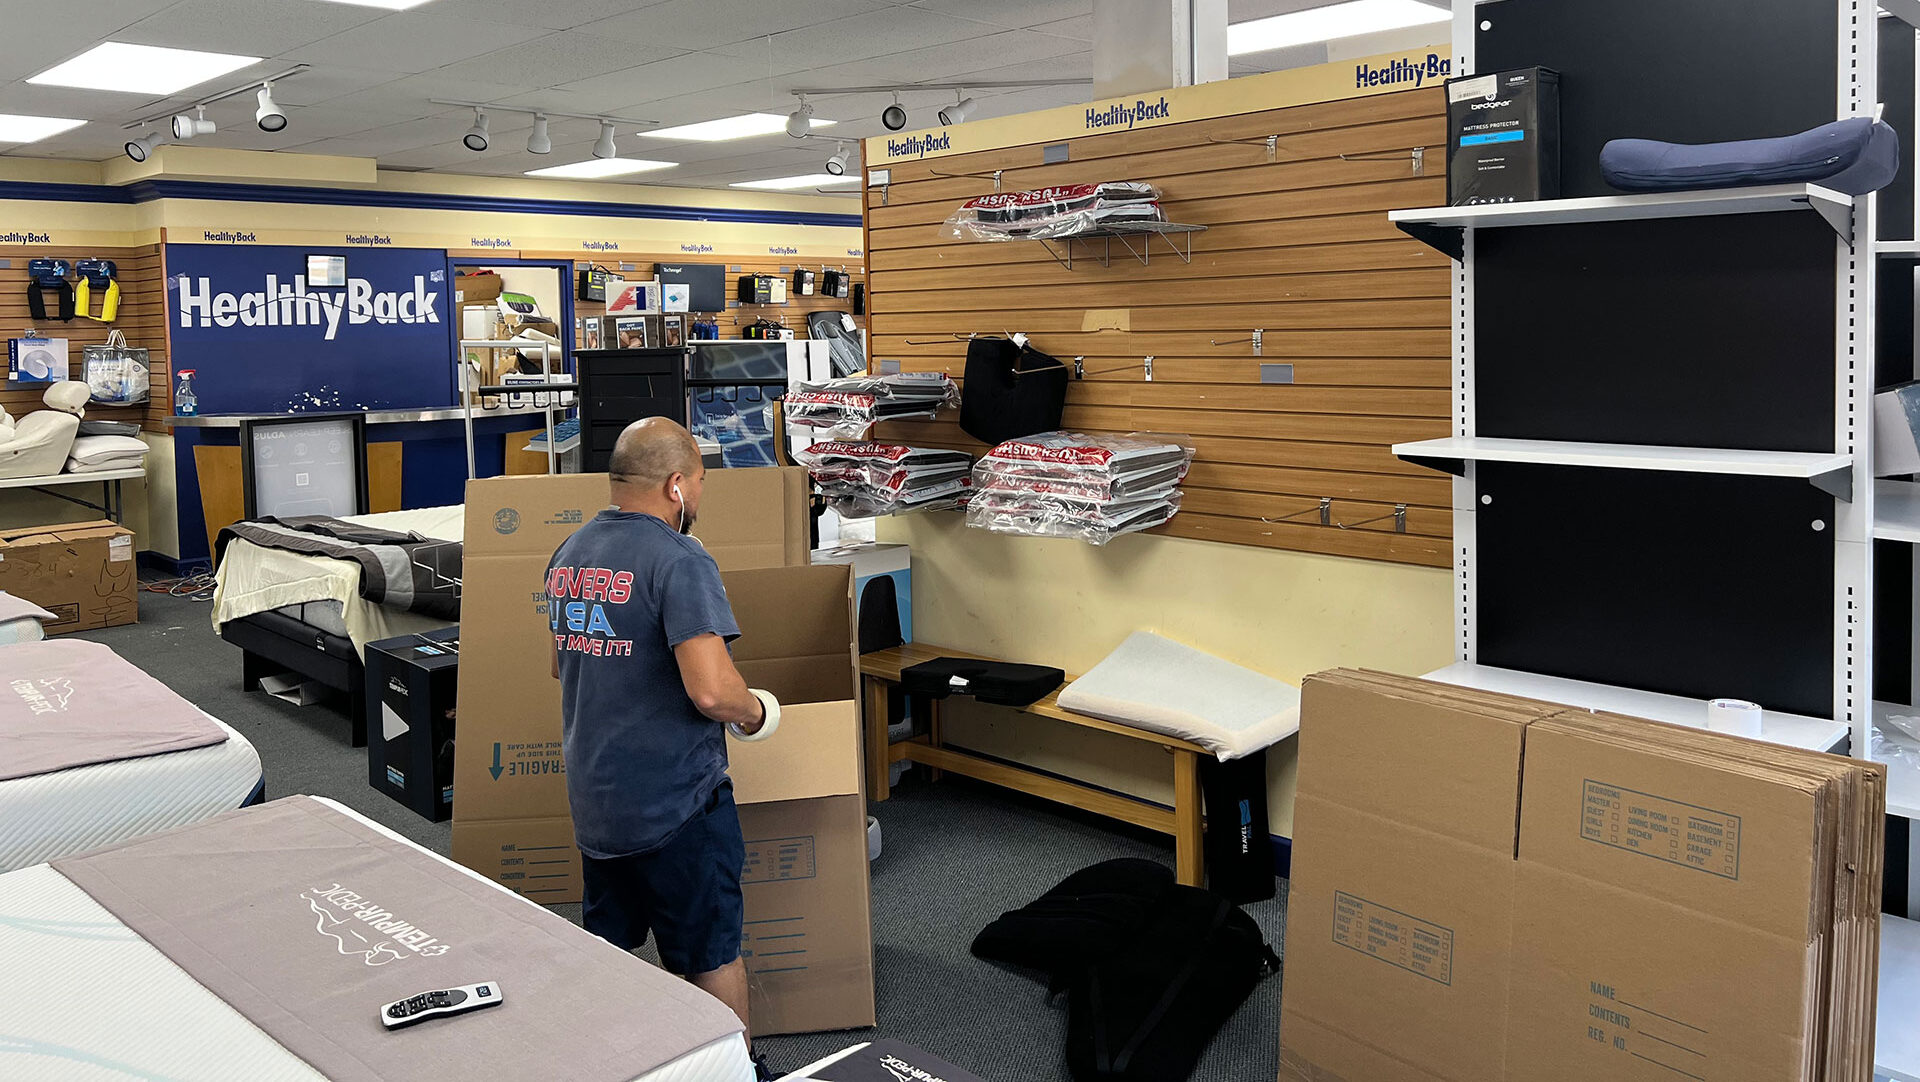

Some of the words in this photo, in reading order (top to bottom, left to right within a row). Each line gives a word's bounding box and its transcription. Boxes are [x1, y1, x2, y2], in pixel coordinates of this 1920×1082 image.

[1356, 53, 1451, 88] HealthyBa
[1471, 99, 1512, 110] bedgear
[1463, 123, 1489, 131] MATTRESS
[1489, 120, 1520, 129] PROTECTOR
[0, 233, 50, 244] ealthyBack
[847, 249, 864, 257] Healthy
[531, 592, 546, 602] REL
[535, 605, 549, 614] ISH
[555, 634, 566, 650] T
[567, 634, 603, 656] MVE
[605, 639, 633, 657] IT!
[1587, 795, 1611, 808] MASTER
[1628, 806, 1648, 818] LIVING
[1688, 820, 1723, 836] BATHROOM
[1687, 832, 1722, 848] BASEMENT
[1590, 981, 1615, 1000] NAME
[1589, 1003, 1631, 1029] CONTENTS
[1588, 1026, 1607, 1043] REG.
[1613, 1035, 1628, 1052] NO.
